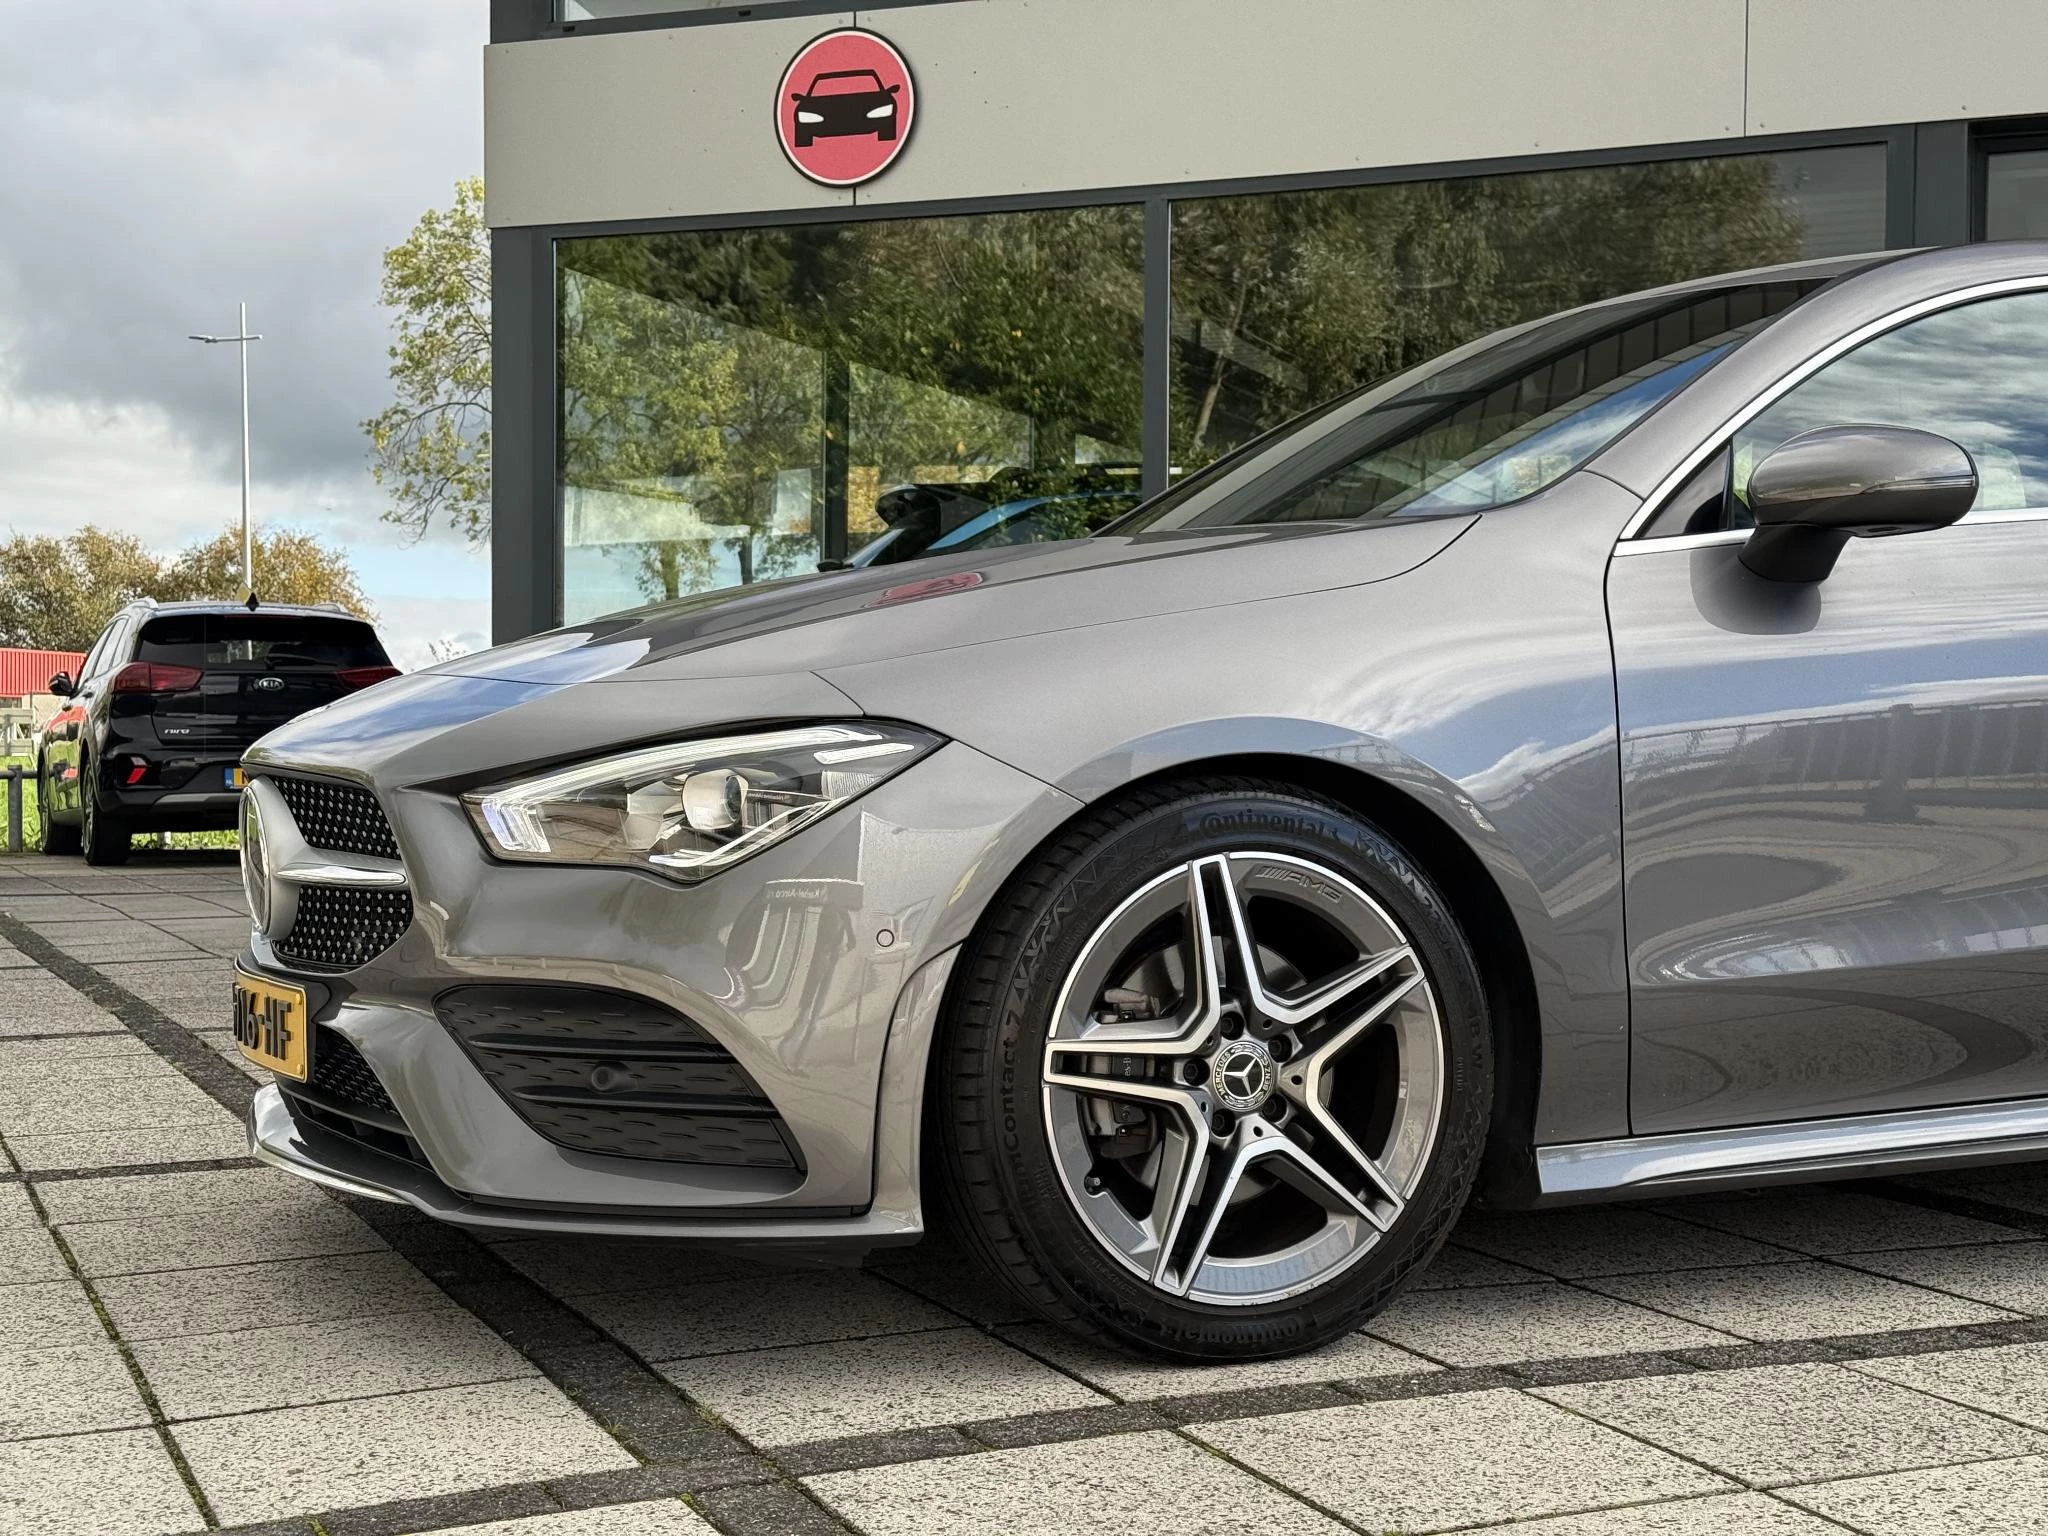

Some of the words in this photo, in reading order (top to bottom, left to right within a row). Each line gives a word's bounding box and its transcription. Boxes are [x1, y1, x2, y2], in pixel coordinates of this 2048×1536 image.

[263, 680, 281, 689] KIA
[1199, 809, 1327, 839] Continental
[1282, 871, 1342, 904] AMG
[1215, 1051, 1231, 1096] MERCEDES
[1263, 1067, 1271, 1091] BENZ
